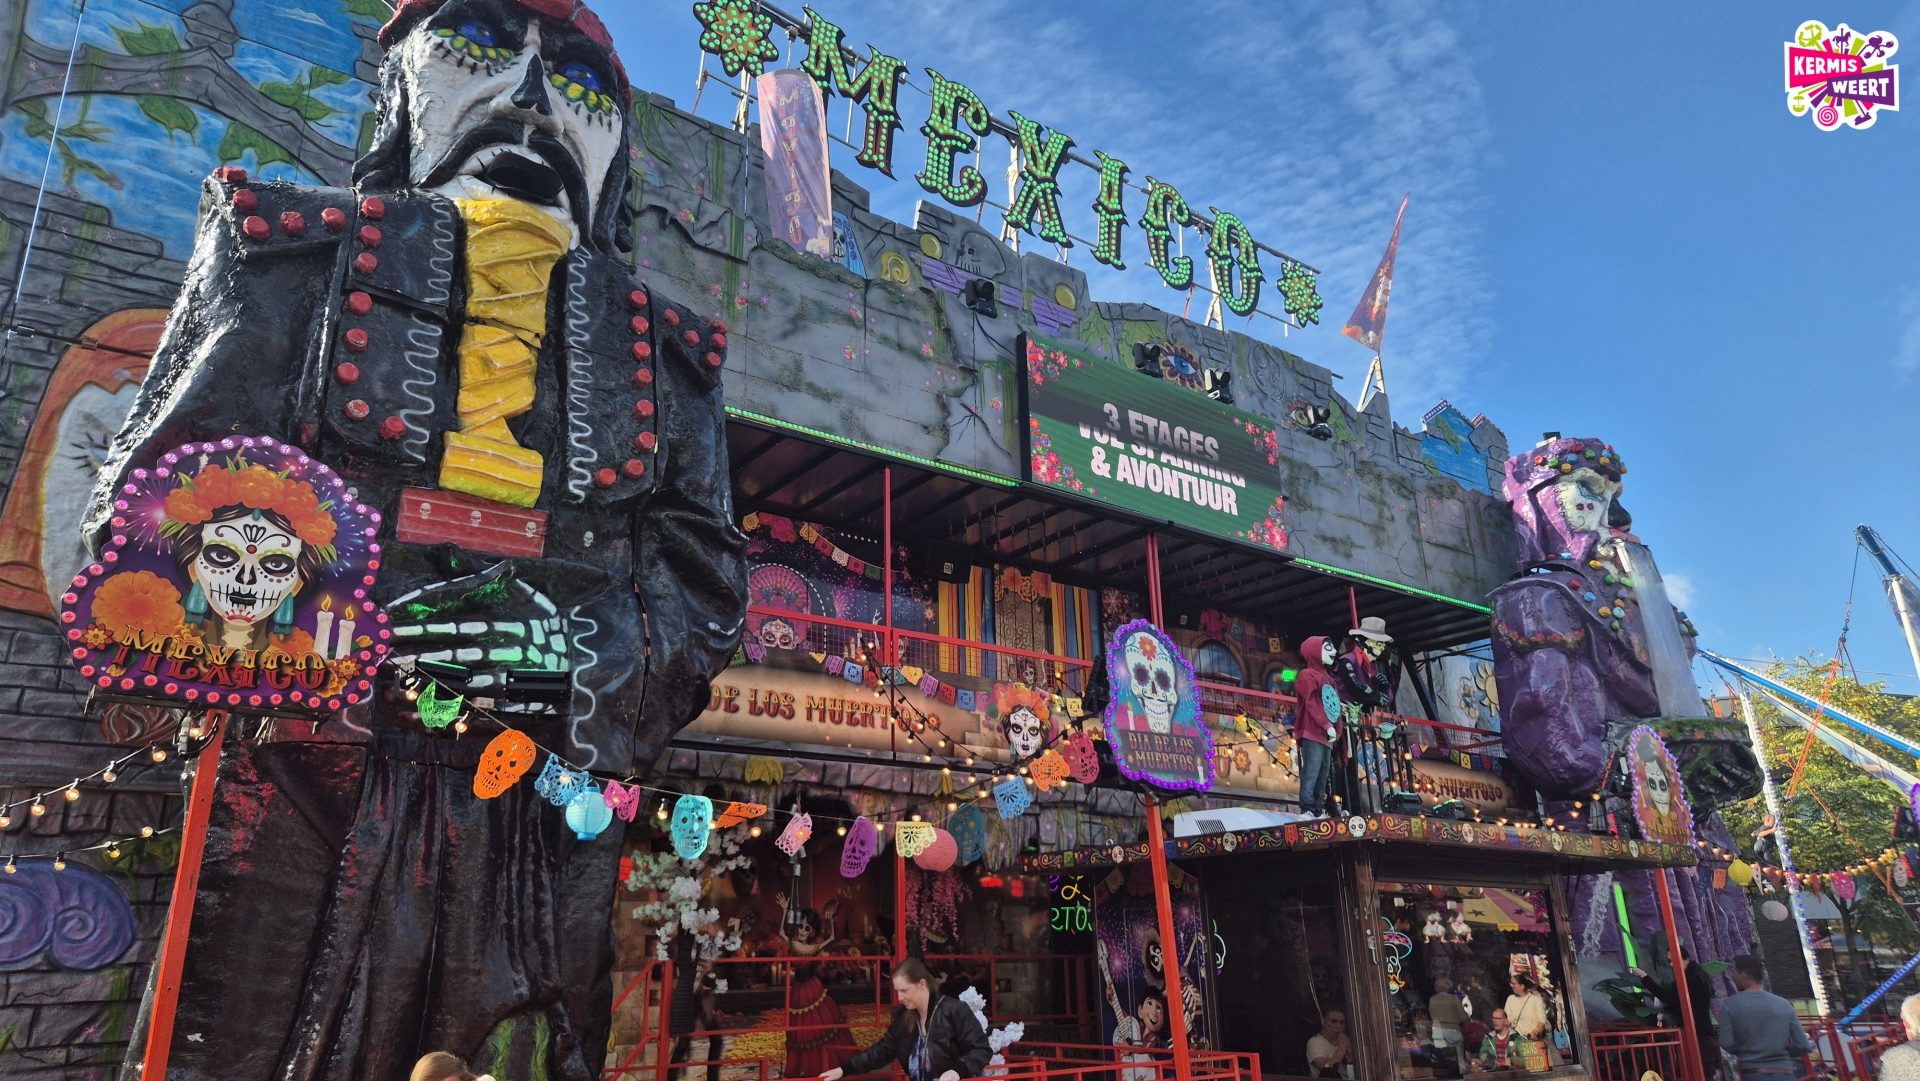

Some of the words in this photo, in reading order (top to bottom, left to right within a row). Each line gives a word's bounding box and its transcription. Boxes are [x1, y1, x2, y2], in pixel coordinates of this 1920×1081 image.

[799, 4, 1266, 316] MEXICO
[1103, 402, 1121, 431] 3
[1127, 409, 1220, 462] ETAGES
[1090, 446, 1112, 479] &
[1116, 453, 1239, 516] AVONTUUR
[111, 623, 327, 690] MEXICO
[706, 683, 739, 713] DE
[748, 688, 795, 720] LOS
[805, 694, 926, 733] MUERTOS
[1127, 732, 1152, 751] DIA
[1153, 734, 1171, 754] DE
[1172, 736, 1195, 755] LOS
[1134, 750, 1195, 772] MUERTOS
